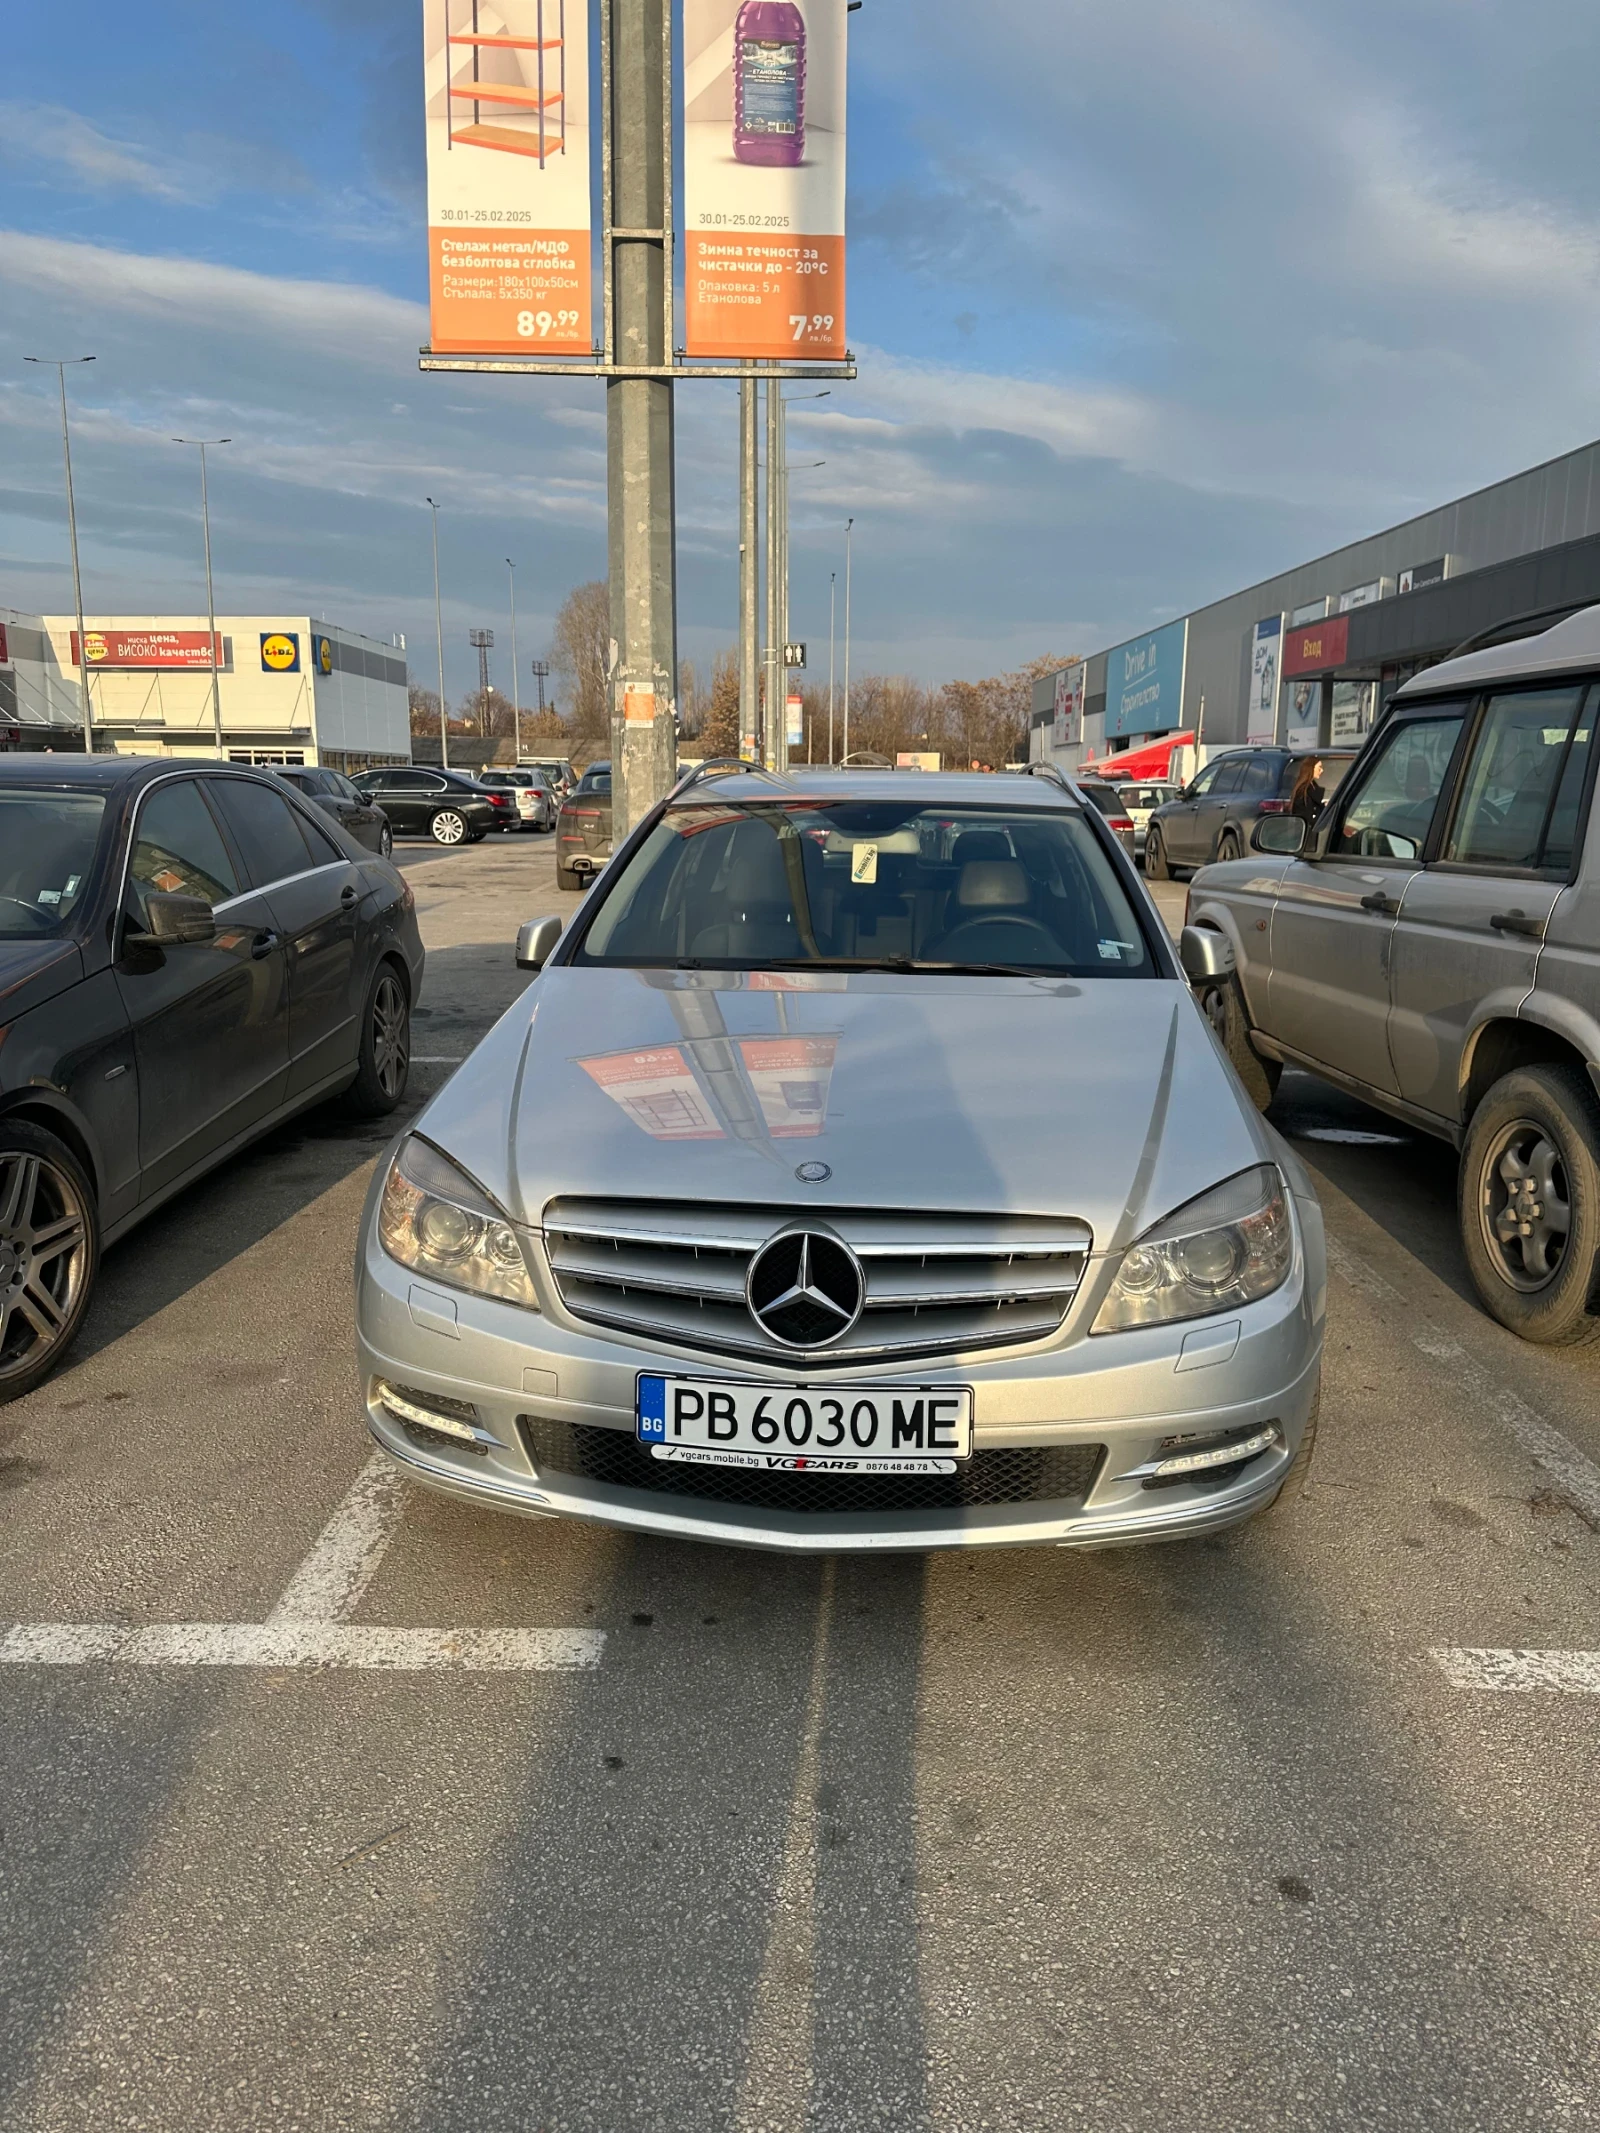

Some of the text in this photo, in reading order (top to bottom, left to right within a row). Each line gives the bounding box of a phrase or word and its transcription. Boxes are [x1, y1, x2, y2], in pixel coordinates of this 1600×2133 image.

[441, 209, 532, 222] 30.01-25.02.2025
[699, 213, 790, 227] 30.01-25.02.2025
[441, 239, 569, 255] Стелаж метал/МДФ
[698, 242, 818, 260] Зимна течност за
[441, 254, 576, 270] безболтова сглобка
[698, 260, 762, 273] чистачки
[765, 263, 783, 275] до
[795, 262, 828, 275] 20°C
[443, 287, 548, 300] Стъпала: 5x350 кг
[698, 279, 780, 293] Опаковка: 5 л
[698, 291, 762, 305] Етанолова
[127, 634, 180, 645] ниска цена,
[117, 644, 157, 657] ВИСОКО
[1303, 639, 1322, 659] Вход
[1125, 637, 1157, 681] Drive in
[1120, 682, 1160, 720] Строителство
[857, 848, 876, 875] mobile.bg
[642, 1416, 663, 1433] BG
[674, 1387, 960, 1449] PB 6030 ME
[680, 1451, 760, 1467] vgcars.mobile.bg
[866, 1463, 889, 1471] 0876
[890, 1463, 902, 1471] 48
[903, 1463, 915, 1471] 48
[917, 1463, 928, 1471] 78
